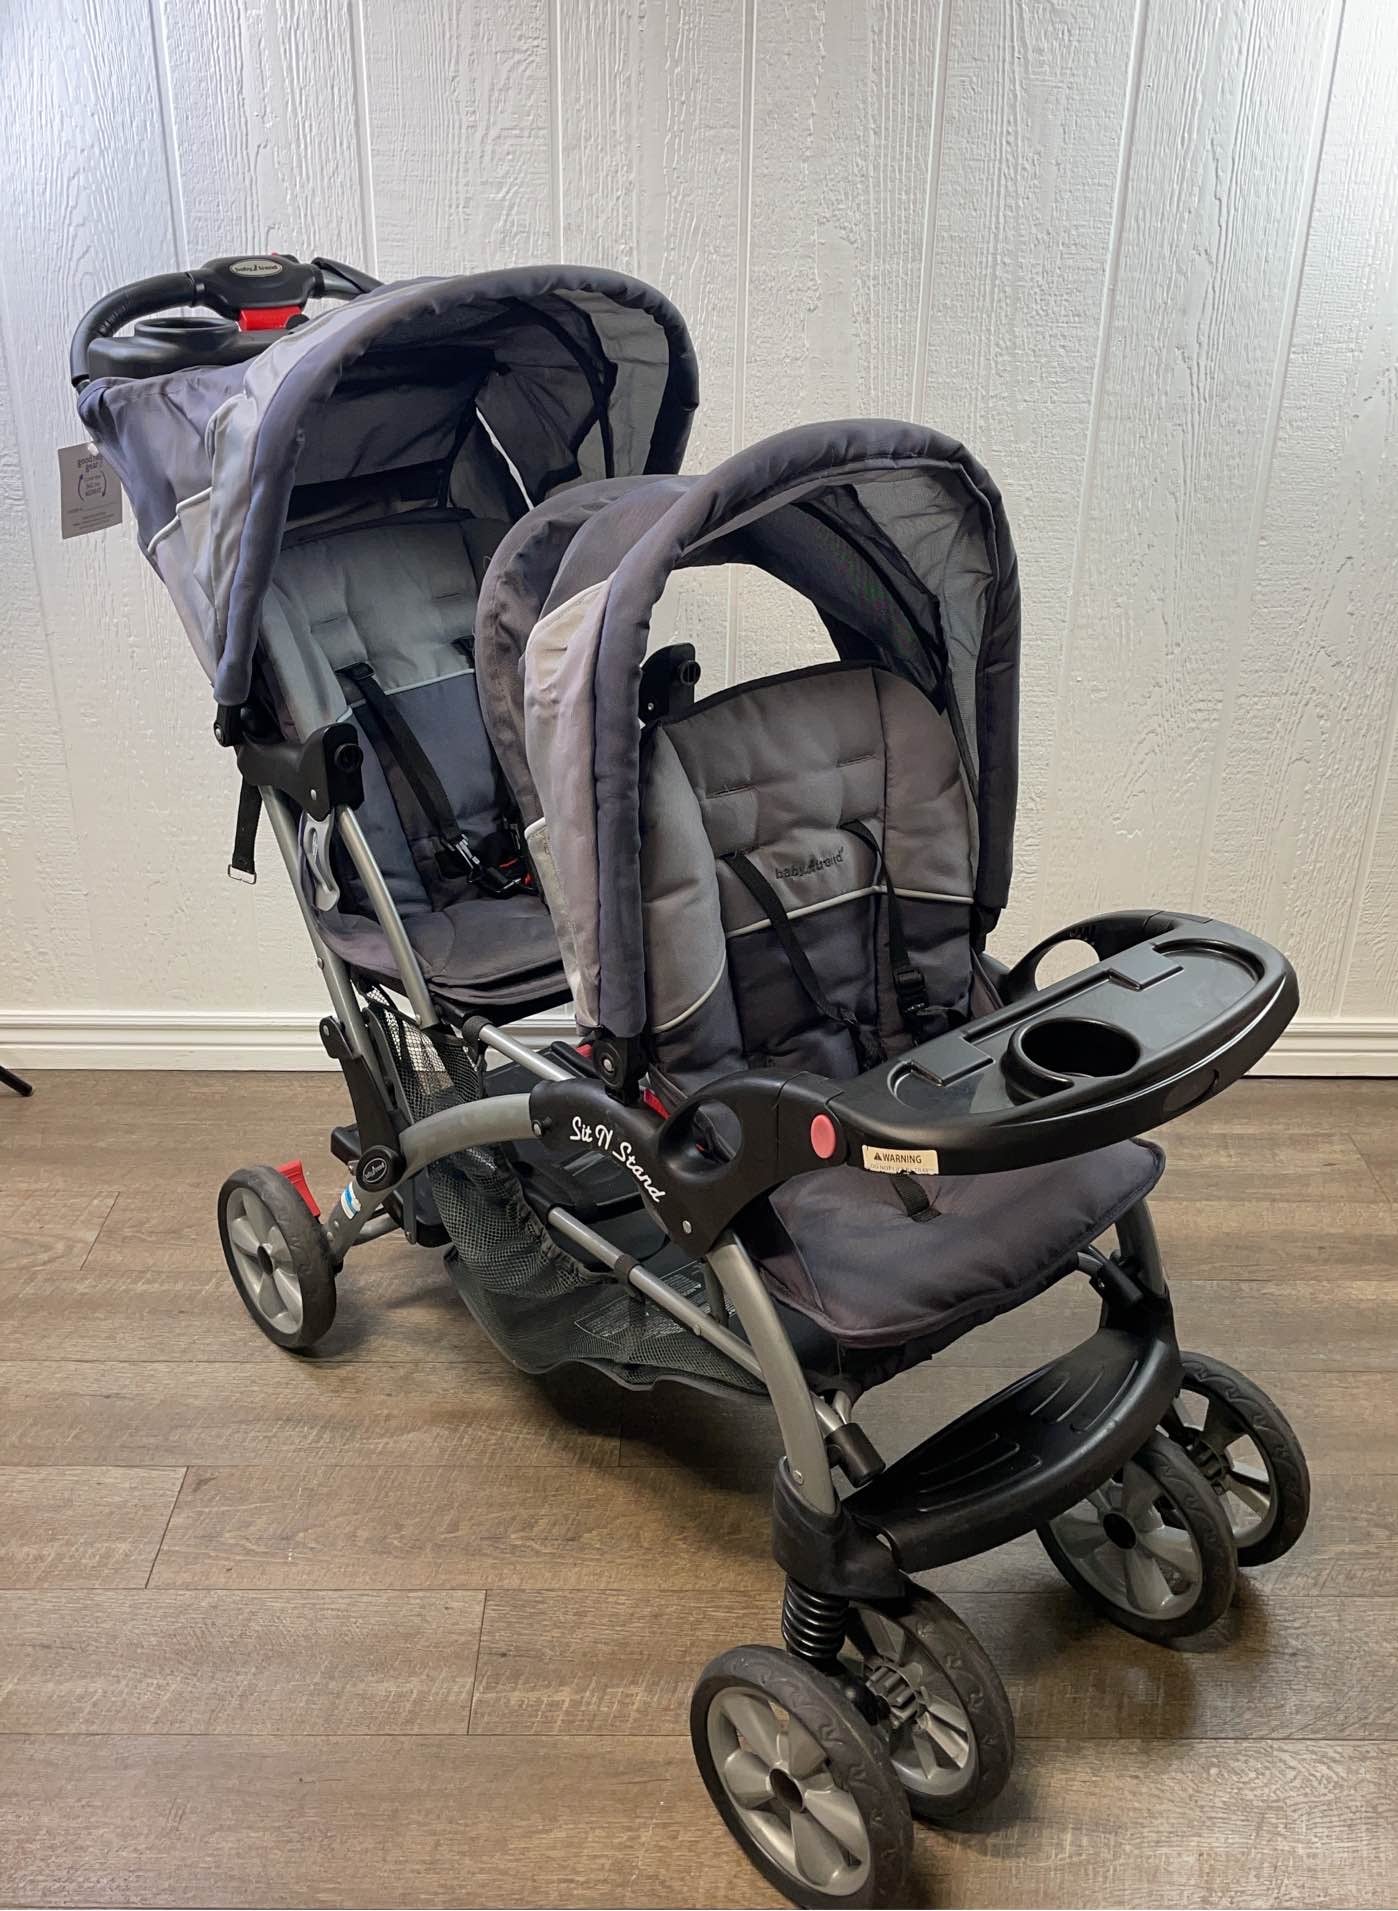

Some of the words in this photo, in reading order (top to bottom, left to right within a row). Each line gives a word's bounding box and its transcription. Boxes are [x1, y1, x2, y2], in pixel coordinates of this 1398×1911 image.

[569, 1116, 593, 1143] Sit
[595, 1124, 614, 1151] N
[612, 1142, 666, 1203] Stand
[882, 1153, 922, 1164] WARNING
